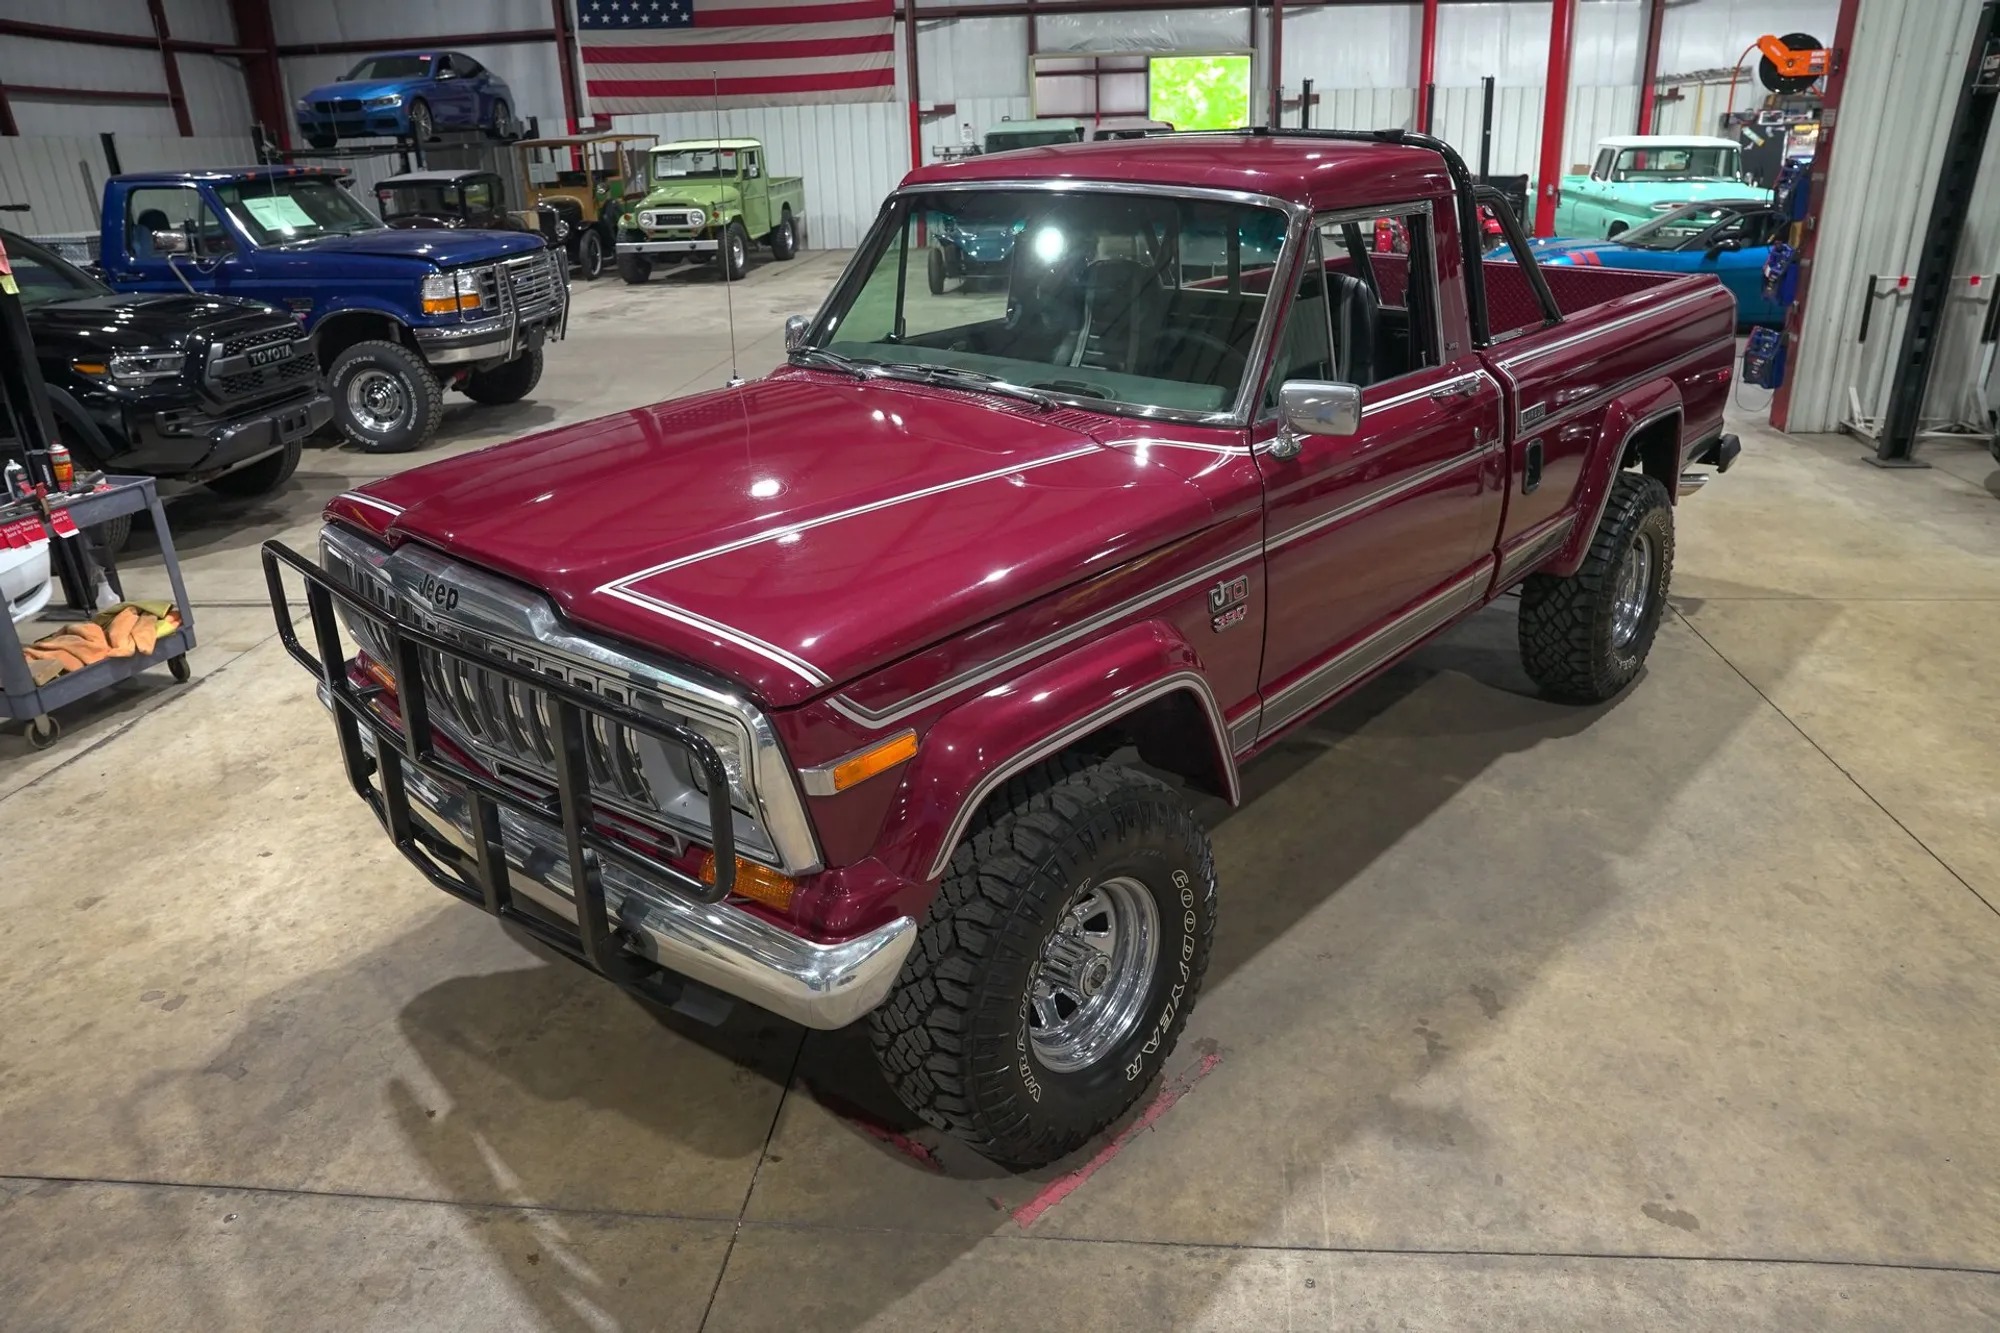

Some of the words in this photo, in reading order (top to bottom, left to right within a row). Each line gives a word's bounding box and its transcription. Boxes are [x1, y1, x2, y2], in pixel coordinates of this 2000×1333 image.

[250, 344, 293, 365] TOYOTA
[418, 573, 459, 611] Jeep
[1213, 580, 1247, 606] J10
[1016, 877, 1091, 1103] WRANG
[1125, 869, 1196, 1081] GOODYEAR
